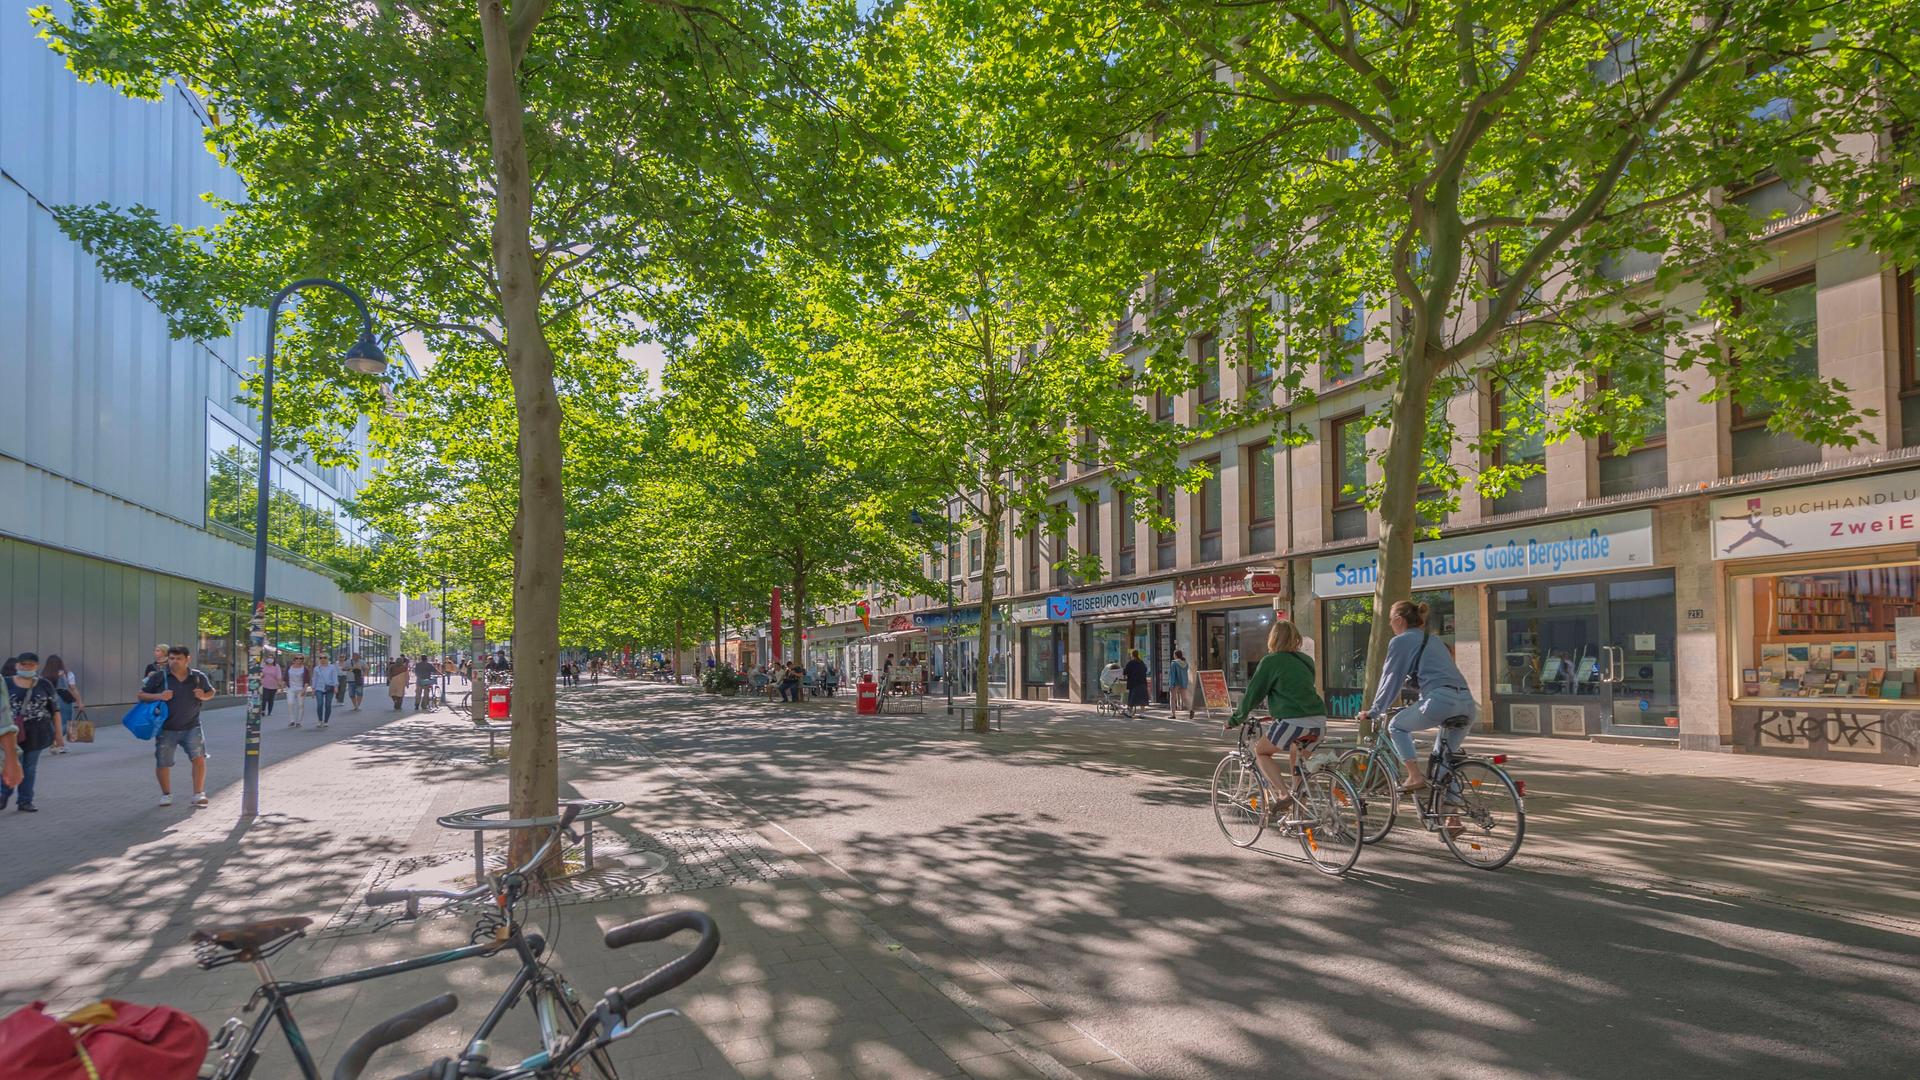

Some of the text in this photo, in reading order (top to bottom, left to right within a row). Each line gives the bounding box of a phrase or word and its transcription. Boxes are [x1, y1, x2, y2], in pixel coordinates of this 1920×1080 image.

[1772, 489, 1916, 517] BUCHHANDLU
[1830, 514, 1914, 536] ZweiE
[1335, 528, 1610, 587] Sanishaus Große Bergstraße
[1190, 576, 1217, 597] Schick
[1072, 589, 1157, 611] REISEBÜRO SYDOW
